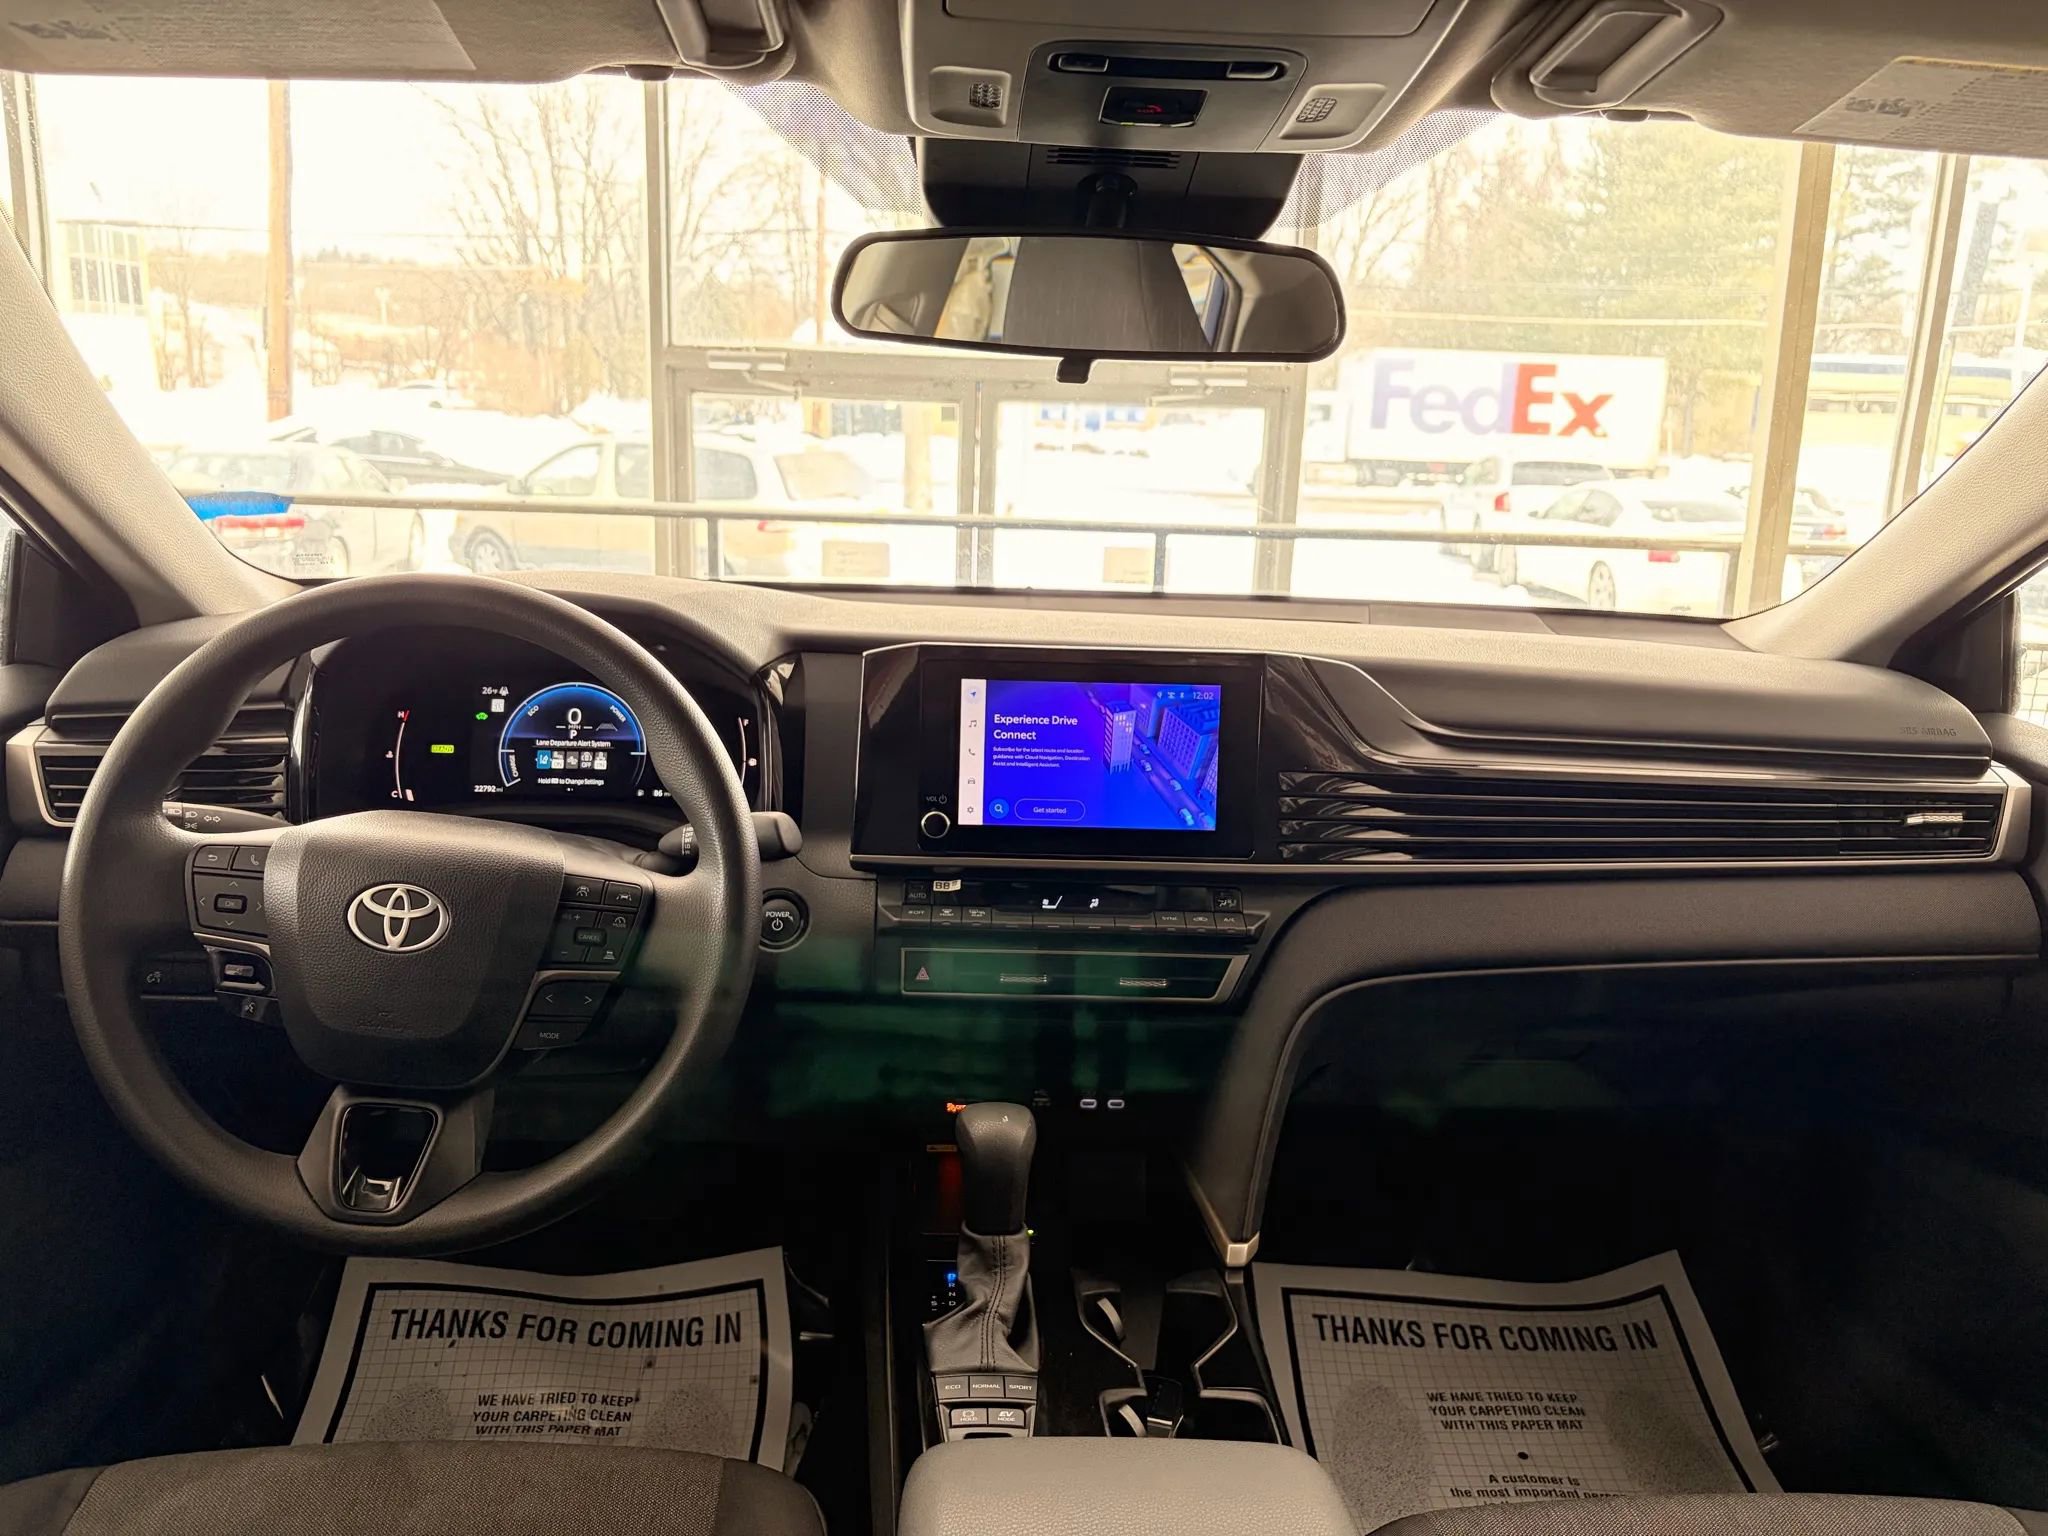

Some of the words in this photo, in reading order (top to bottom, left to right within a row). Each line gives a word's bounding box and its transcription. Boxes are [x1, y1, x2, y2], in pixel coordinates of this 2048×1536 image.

[1370, 358, 1613, 437] FedEx
[528, 705, 540, 717] ECO
[568, 708, 582, 724] 0
[610, 705, 626, 722] POWER
[994, 714, 1050, 726] Experience
[1052, 715, 1078, 726] Drive
[570, 730, 577, 739] P
[993, 730, 1036, 740] Connect
[1921, 727, 1957, 737] AIRBAG
[550, 740, 577, 748] Departure
[591, 740, 611, 748] System
[539, 1032, 560, 1040] MODE
[391, 1309, 508, 1340] THANKS
[517, 1314, 578, 1344] FOR
[588, 1317, 704, 1348] COMING
[715, 1312, 741, 1344] IN
[1312, 1314, 1426, 1348] THANKS
[1432, 1323, 1492, 1350] FOR
[1498, 1326, 1618, 1352] COMING
[1622, 1320, 1658, 1350] IN
[478, 1394, 498, 1407] WE
[502, 1393, 535, 1406] HAVE
[540, 1392, 576, 1405] TRIED
[580, 1392, 598, 1404] TO
[601, 1394, 634, 1407] KEEP
[1426, 1392, 1450, 1402] WE
[1450, 1392, 1483, 1402] HAVE
[1486, 1392, 1523, 1402] TRIED
[1528, 1392, 1544, 1402] TO
[1548, 1392, 1578, 1403] KEEP
[473, 1410, 508, 1422] YOUR
[513, 1408, 586, 1422] CARPETING
[590, 1409, 632, 1422] CLEAN
[1429, 1405, 1465, 1416] YOUR
[1469, 1405, 1540, 1416] CARPETING
[1544, 1405, 1586, 1416] CLEAN
[475, 1426, 512, 1435] WITH
[514, 1425, 544, 1434] THIS
[548, 1425, 591, 1435] PAPER
[594, 1426, 622, 1436] MAT
[1440, 1420, 1475, 1430] WITH
[1476, 1420, 1508, 1430] THIS
[1512, 1420, 1552, 1430] PAPER
[1557, 1420, 1583, 1430] MAT
[1488, 1474, 1499, 1484] A
[1502, 1474, 1564, 1485] customer
[1450, 1488, 1472, 1498] the
[1476, 1487, 1510, 1498] most
[1514, 1487, 1580, 1499] important
